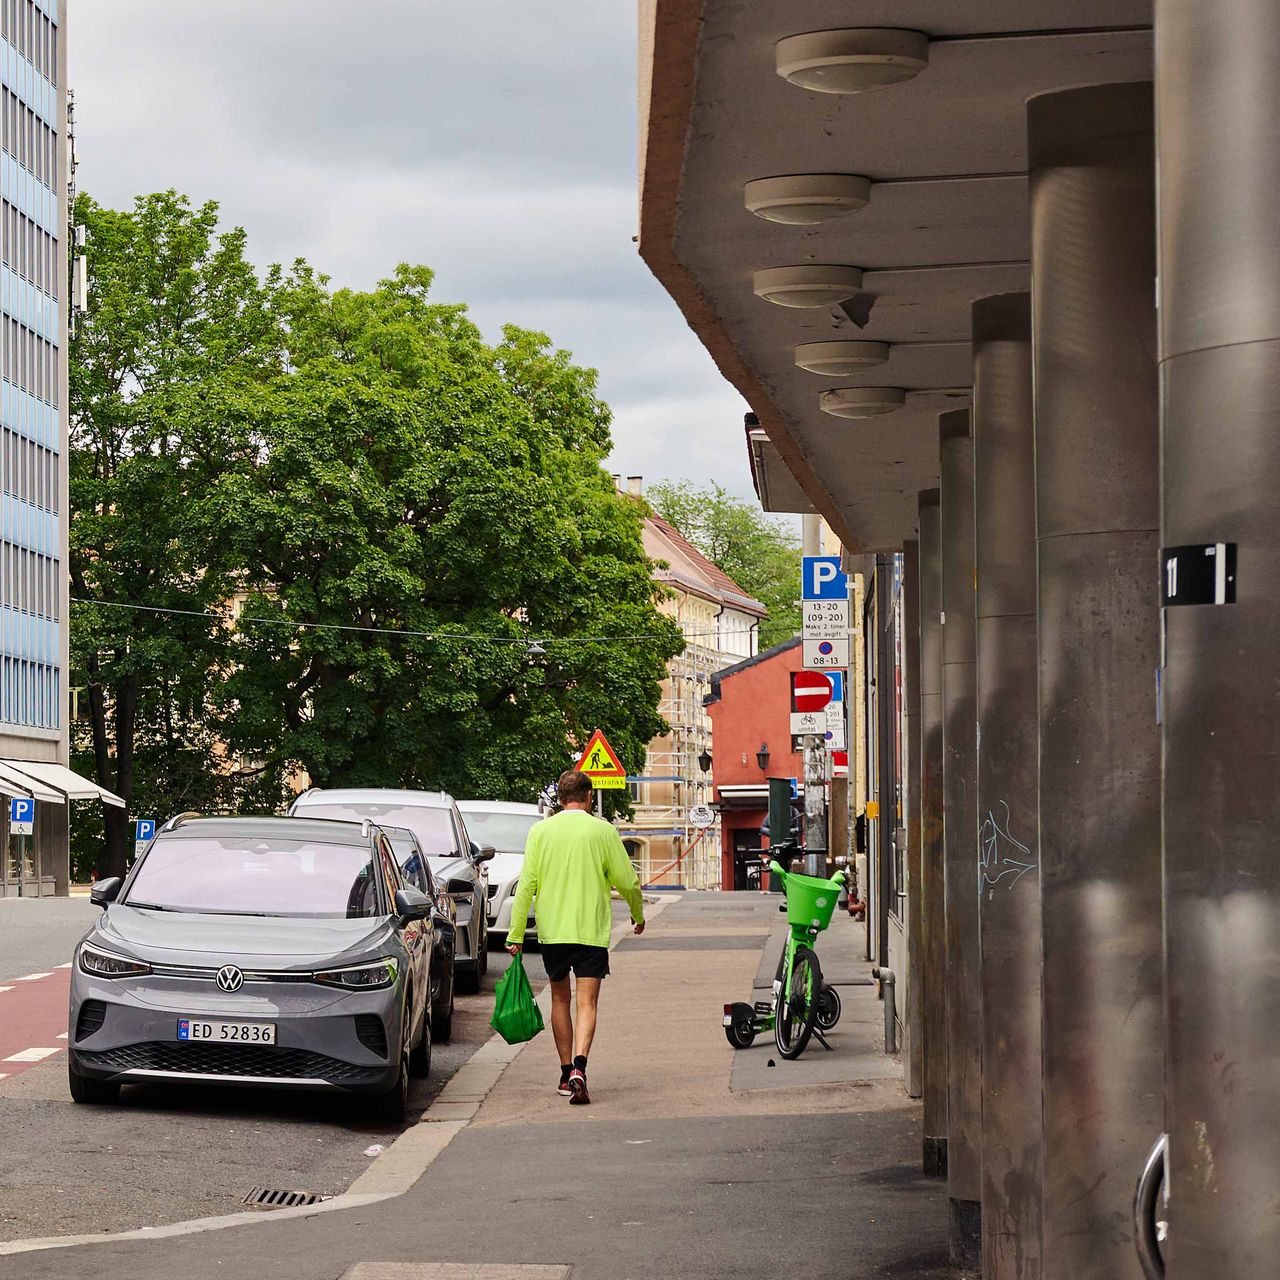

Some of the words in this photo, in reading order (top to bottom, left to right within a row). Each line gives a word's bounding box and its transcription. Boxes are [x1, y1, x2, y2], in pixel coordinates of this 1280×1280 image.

[813, 562, 837, 595] P
[1166, 557, 1178, 598] 11
[592, 778, 624, 786] gstrafikk
[16, 802, 29, 820] P
[141, 822, 150, 838] P
[192, 1024, 212, 1038] ED
[220, 1025, 270, 1042] 52836
